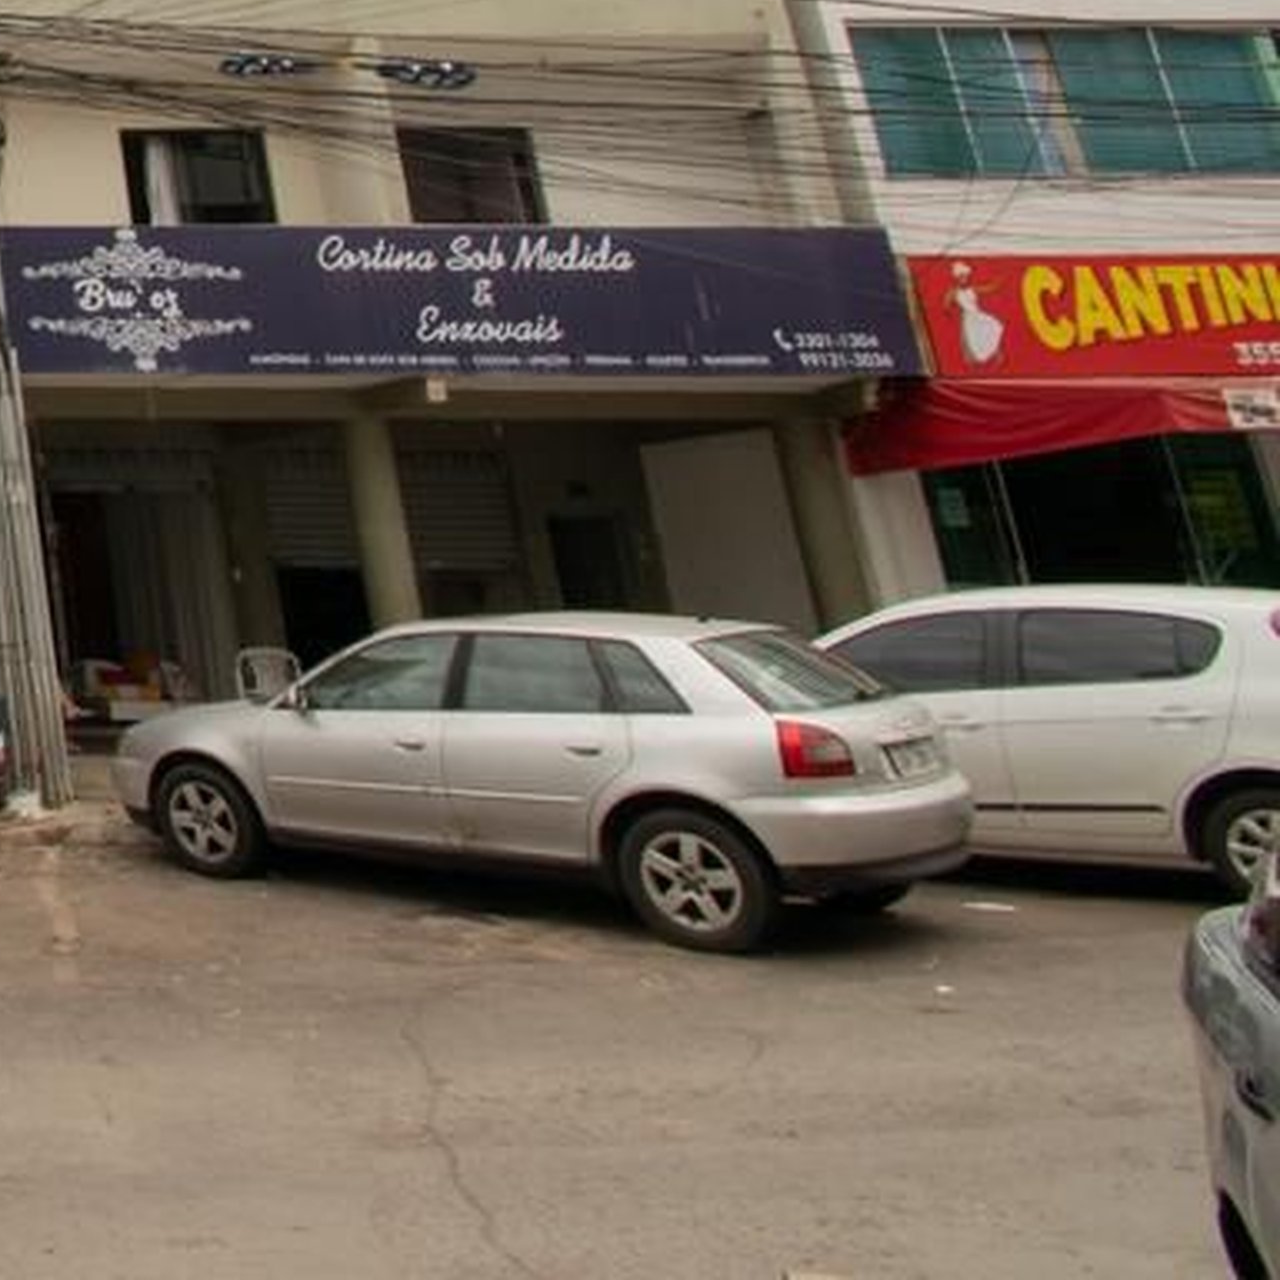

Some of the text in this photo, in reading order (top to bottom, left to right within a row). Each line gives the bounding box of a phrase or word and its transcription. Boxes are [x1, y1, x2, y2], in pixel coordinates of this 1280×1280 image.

[317, 234, 634, 272] Cortina Sob Medida
[472, 278, 493, 307] &
[1021, 265, 1280, 352] CANTIN
[417, 306, 562, 342] Enxovais
